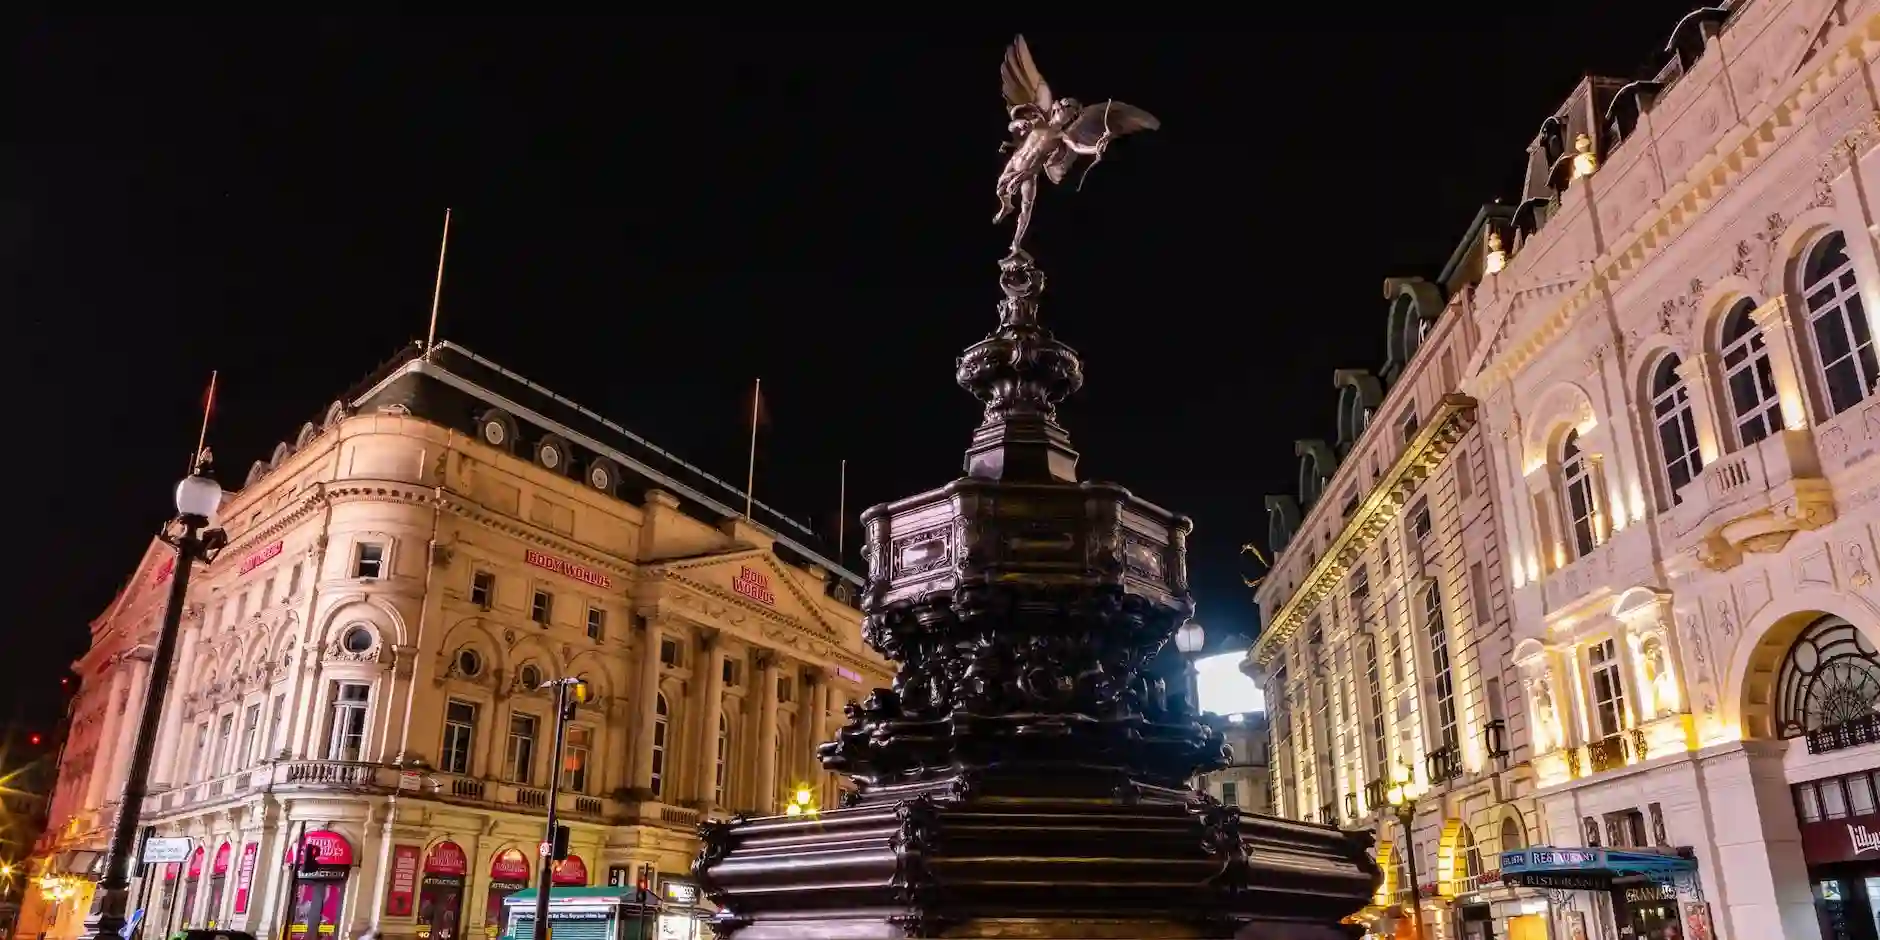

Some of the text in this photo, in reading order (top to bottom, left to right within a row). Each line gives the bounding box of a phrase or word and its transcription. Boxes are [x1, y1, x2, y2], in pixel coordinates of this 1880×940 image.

[526, 549, 612, 589] BODY WORLDS
[741, 565, 769, 587] BODY
[732, 576, 775, 606] WORLDS
[1533, 852, 1595, 865] RESTAURANT
